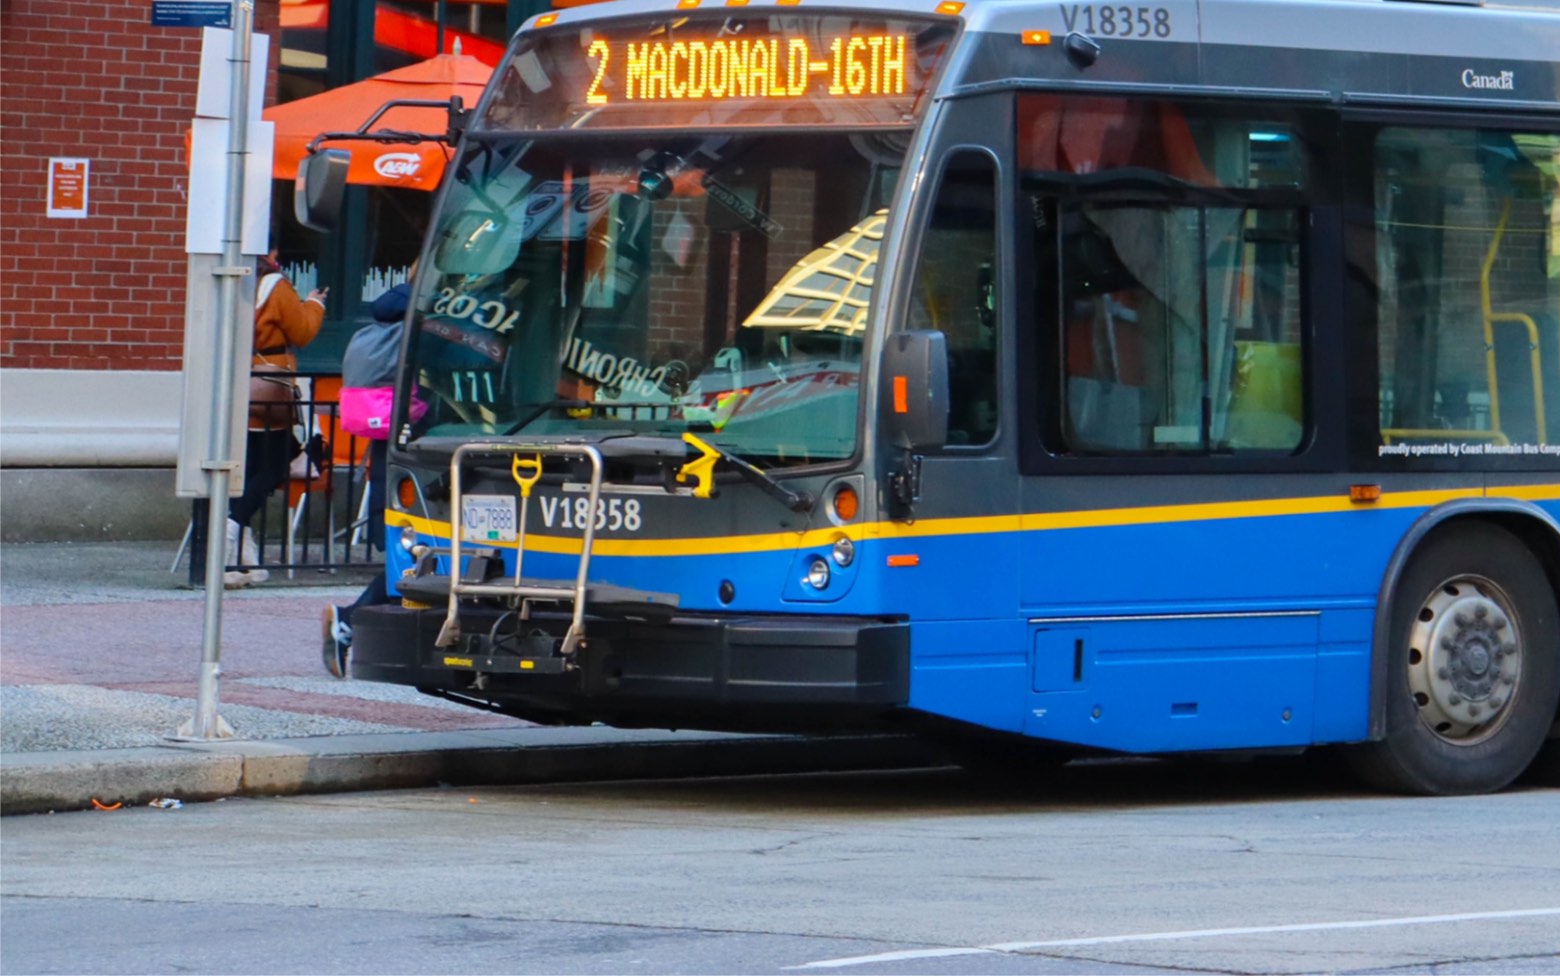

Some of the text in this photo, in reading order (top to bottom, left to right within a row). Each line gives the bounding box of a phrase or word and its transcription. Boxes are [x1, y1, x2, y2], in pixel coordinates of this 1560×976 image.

[1059, 4, 1171, 37] V18358
[586, 35, 905, 104] 2 MACDONALD-16TH
[1462, 68, 1514, 90] Canada
[1378, 443, 1410, 457] proudly
[1411, 443, 1448, 456] operated
[1449, 442, 1459, 457] by
[1460, 443, 1483, 454] Coast
[1484, 443, 1522, 454] Mountain
[1523, 443, 1539, 454] Bus
[539, 496, 642, 532] V18358
